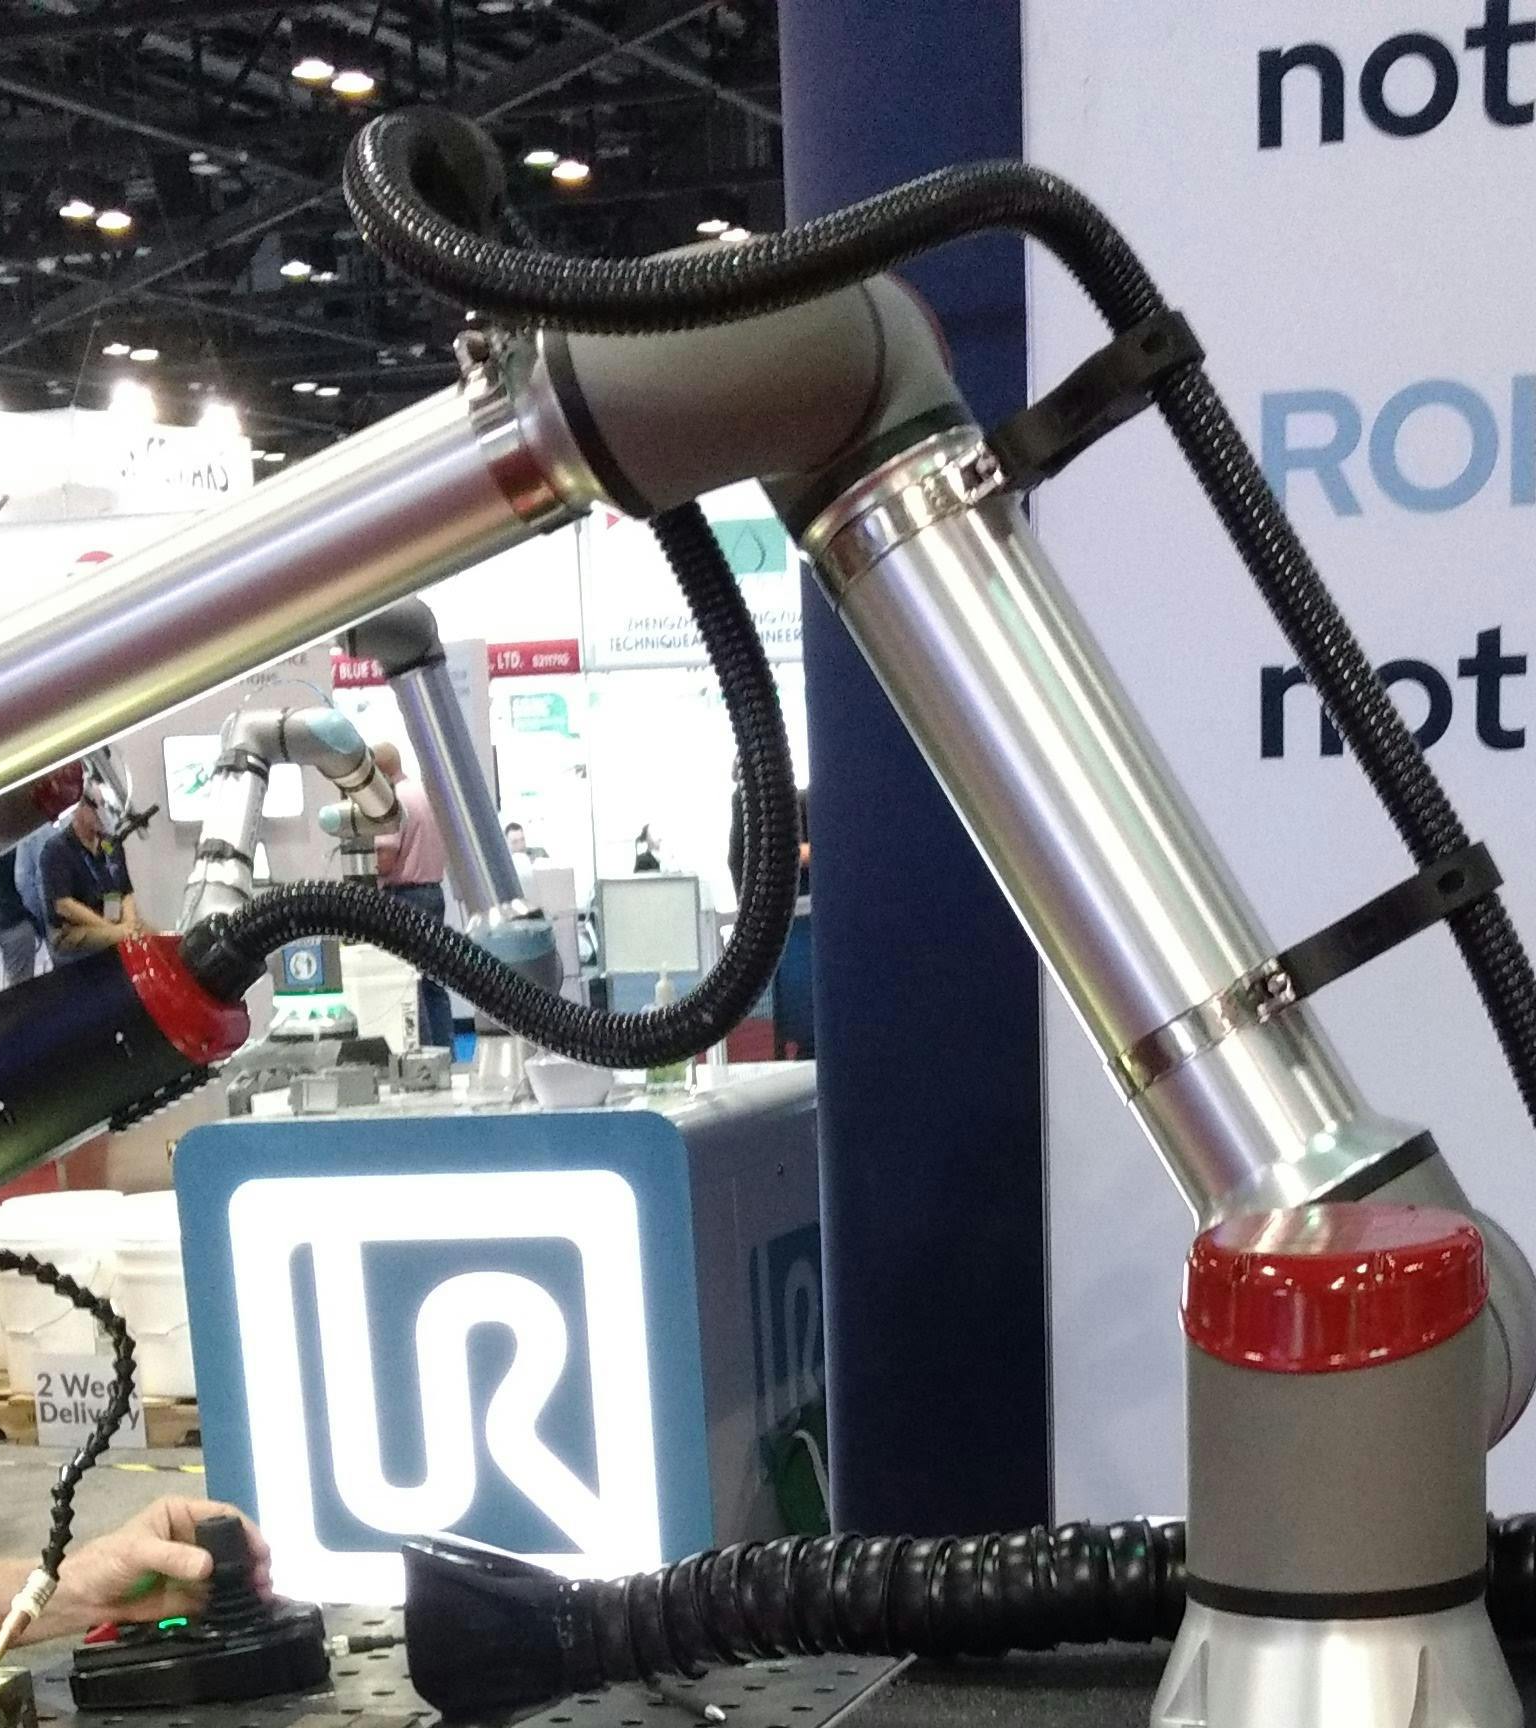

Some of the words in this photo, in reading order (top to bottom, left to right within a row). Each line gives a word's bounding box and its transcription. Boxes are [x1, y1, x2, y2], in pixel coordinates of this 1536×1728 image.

[339, 661, 369, 680] BLUE
[1257, 627, 1529, 760] not
[37, 1373, 53, 1398] 2
[39, 1402, 140, 1431] Delivy
